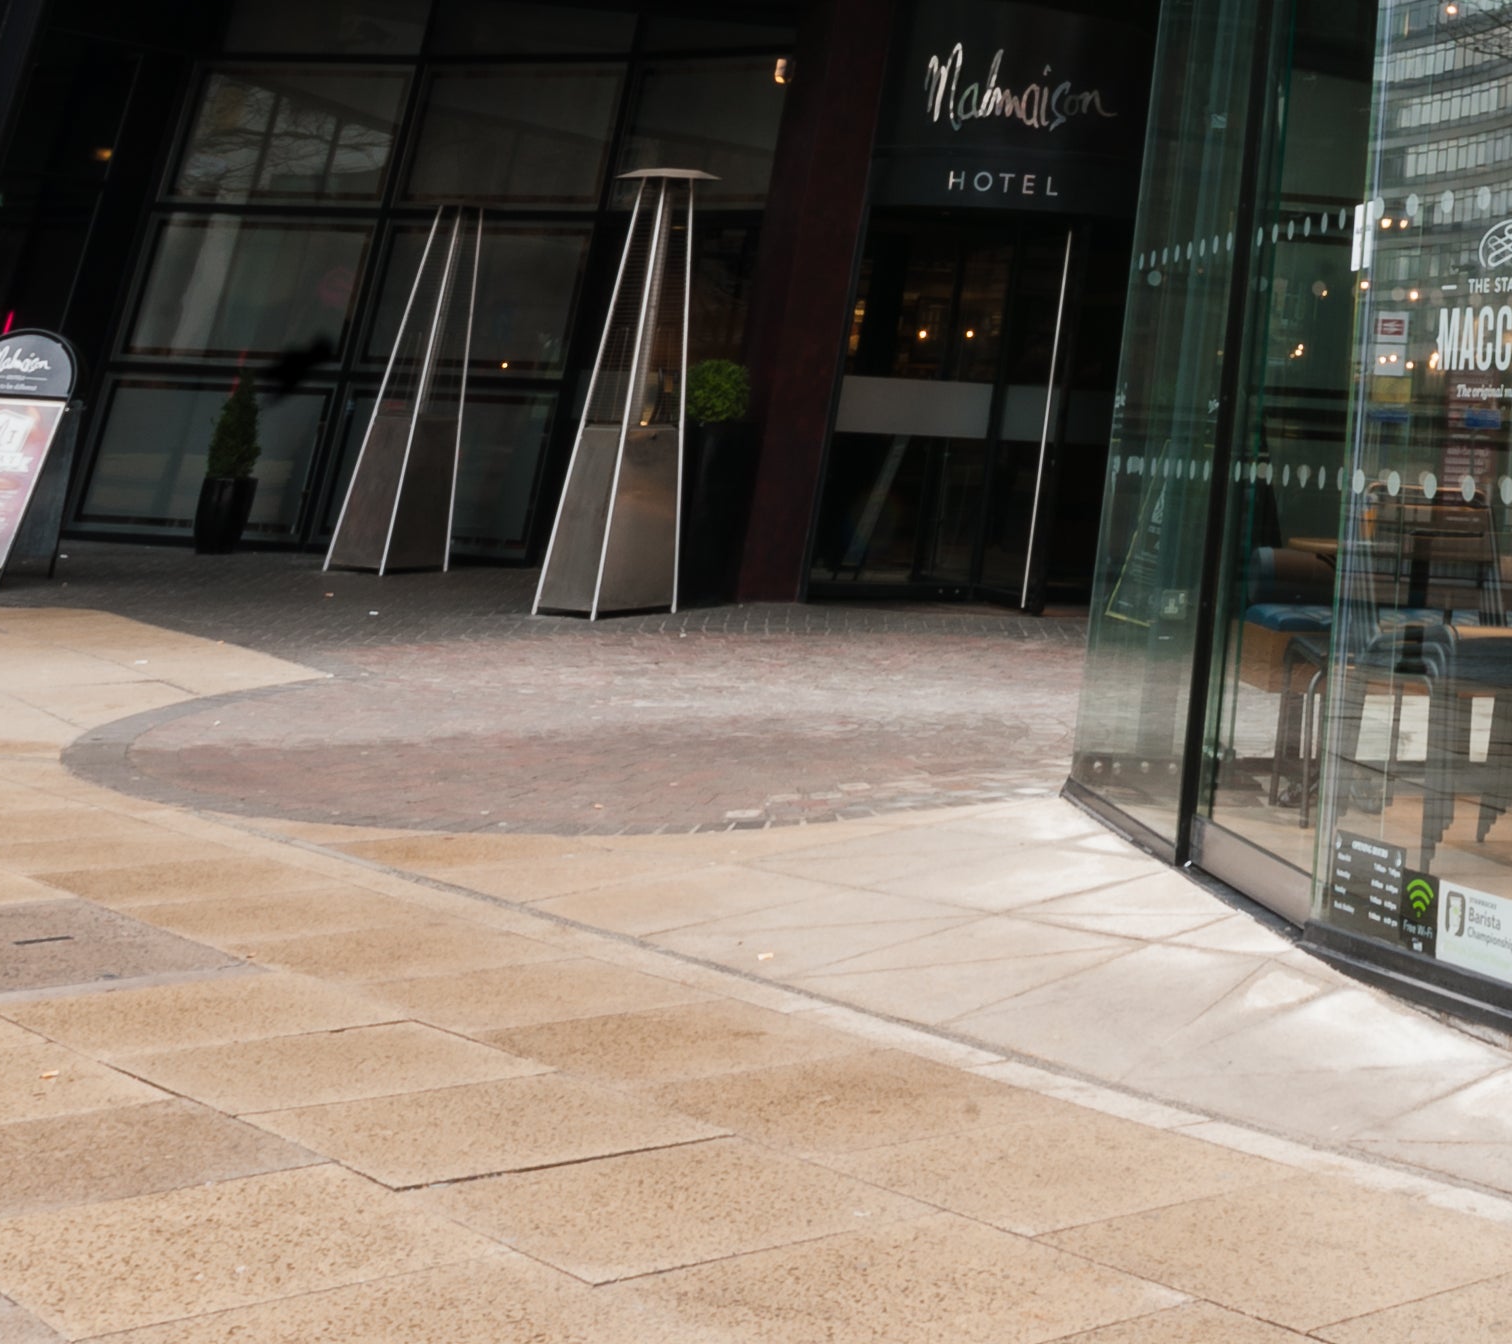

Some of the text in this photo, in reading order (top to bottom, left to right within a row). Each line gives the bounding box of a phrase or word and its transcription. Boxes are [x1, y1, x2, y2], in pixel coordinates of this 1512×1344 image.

[925, 42, 1118, 132] Malmaison
[948, 170, 1058, 196] HOTEL
[1468, 278, 1490, 293] THE
[1456, 383, 1470, 398] The
[1472, 383, 1504, 400] original
[1403, 919, 1417, 933] Free
[1417, 923, 1433, 939] Wi-Fi
[1468, 906, 1501, 930] Barista
